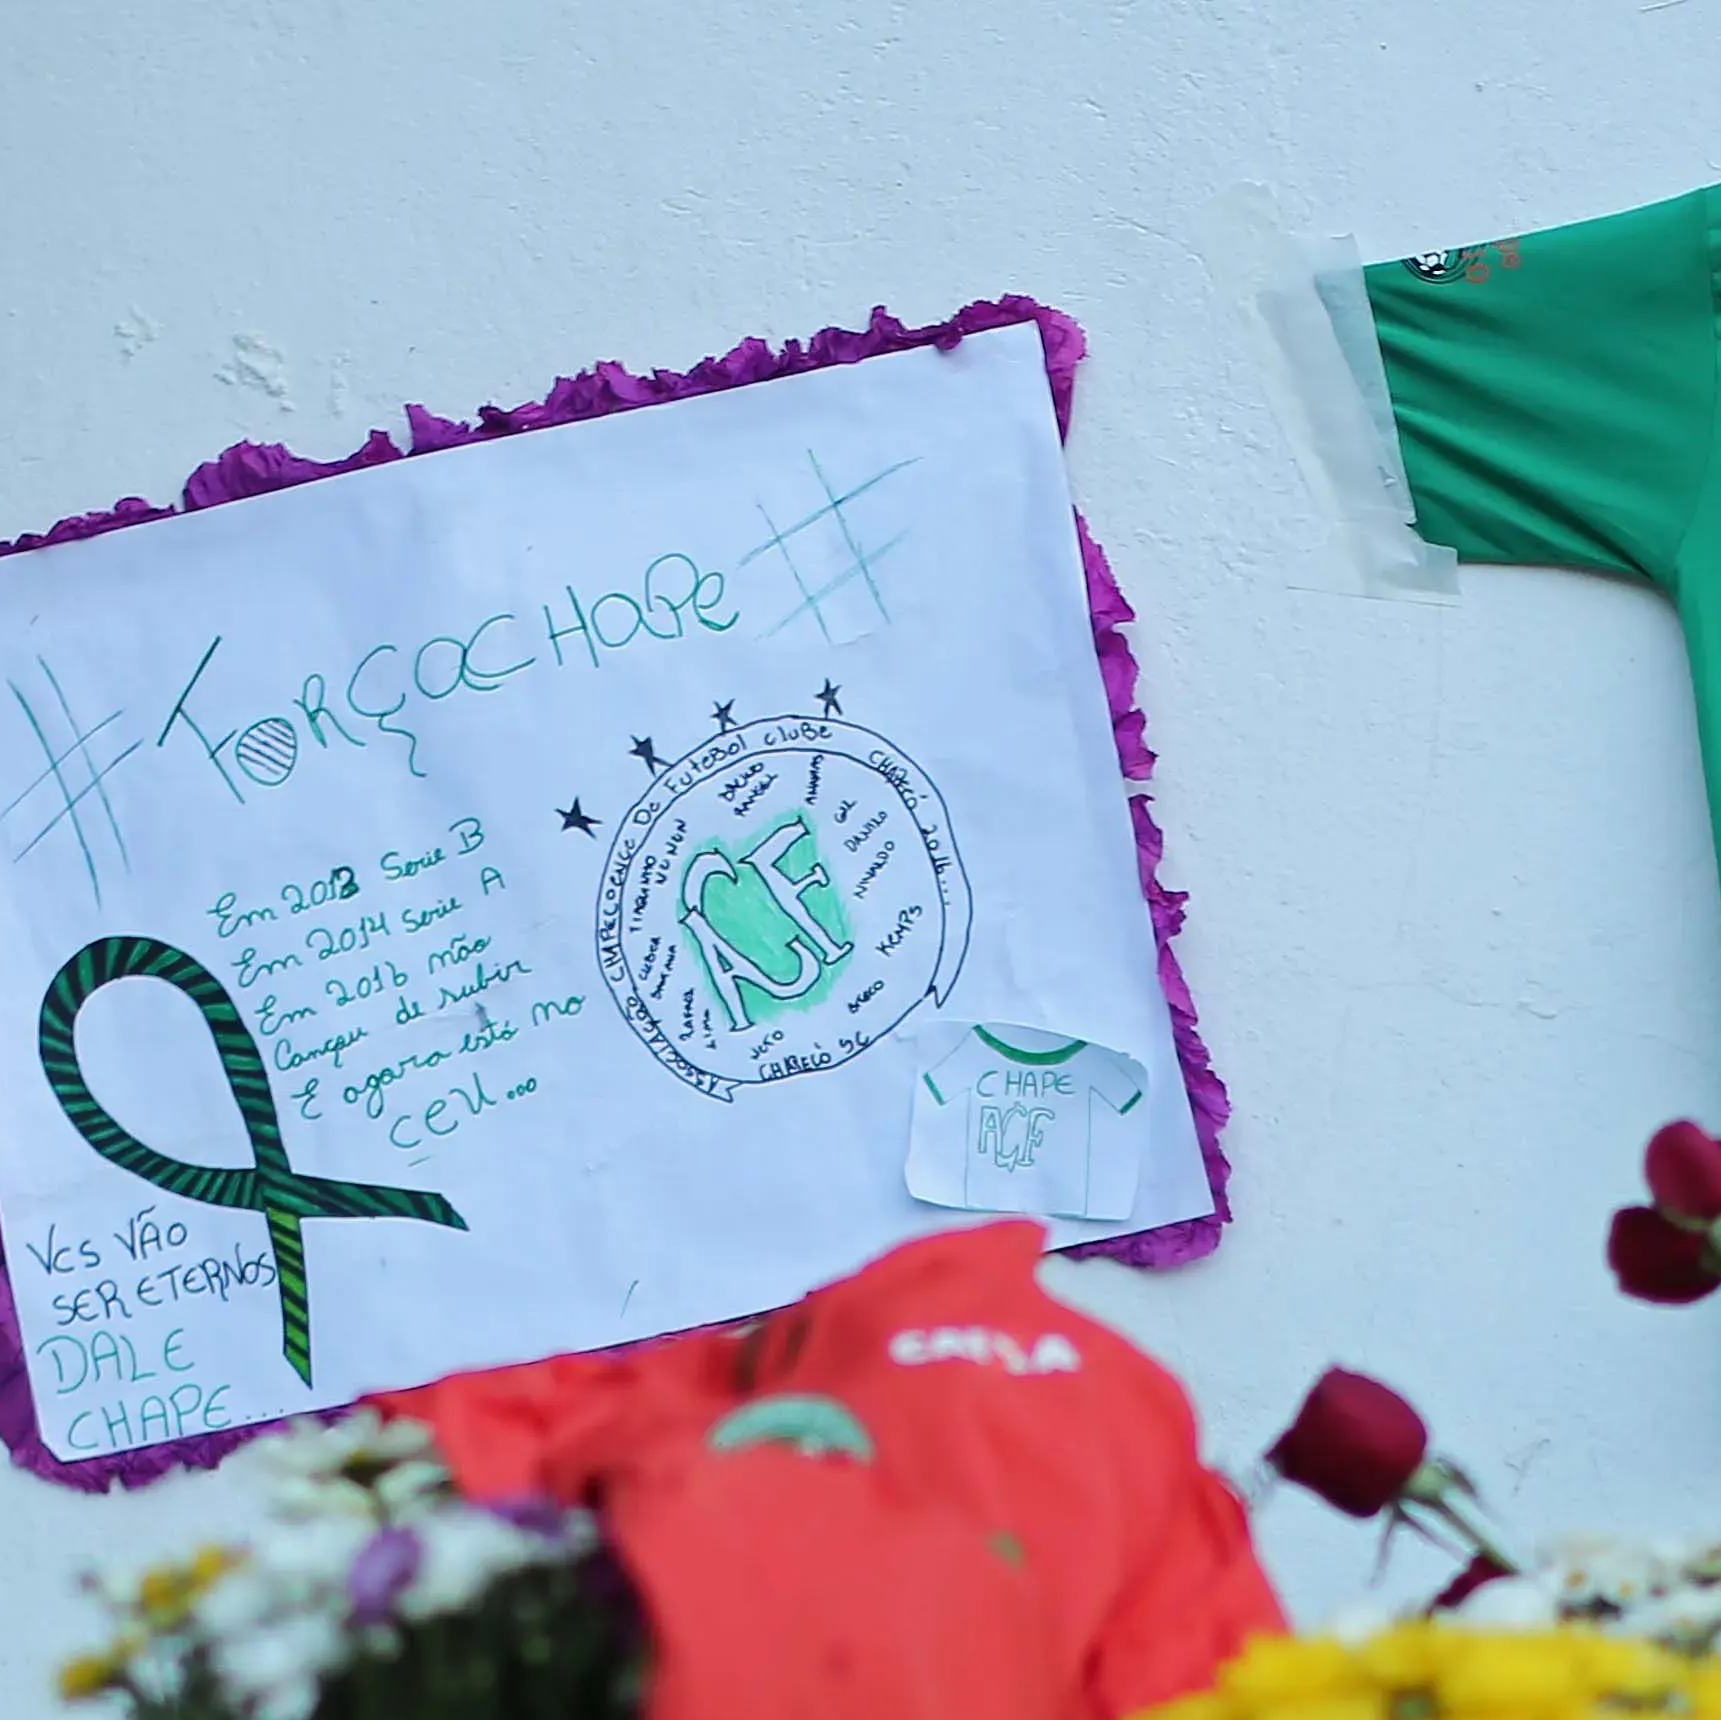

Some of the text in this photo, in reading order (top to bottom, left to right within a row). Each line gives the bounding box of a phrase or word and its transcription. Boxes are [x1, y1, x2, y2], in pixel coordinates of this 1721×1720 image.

[207, 892, 278, 938] Em
[449, 817, 485, 855] B
[231, 947, 303, 988] Em
[306, 911, 391, 961] 2014
[480, 866, 506, 895] A
[254, 933, 492, 1036] Em 2016 não
[396, 995, 426, 1026] de
[438, 958, 533, 1011] subir
[291, 1078, 323, 1120] E
[532, 994, 588, 1027] no
[976, 1070, 1076, 1098] CHAPE
[114, 1204, 189, 1261] VÃO
[52, 1242, 278, 1327] SER ETERNOS
[35, 1328, 195, 1395] DALE
